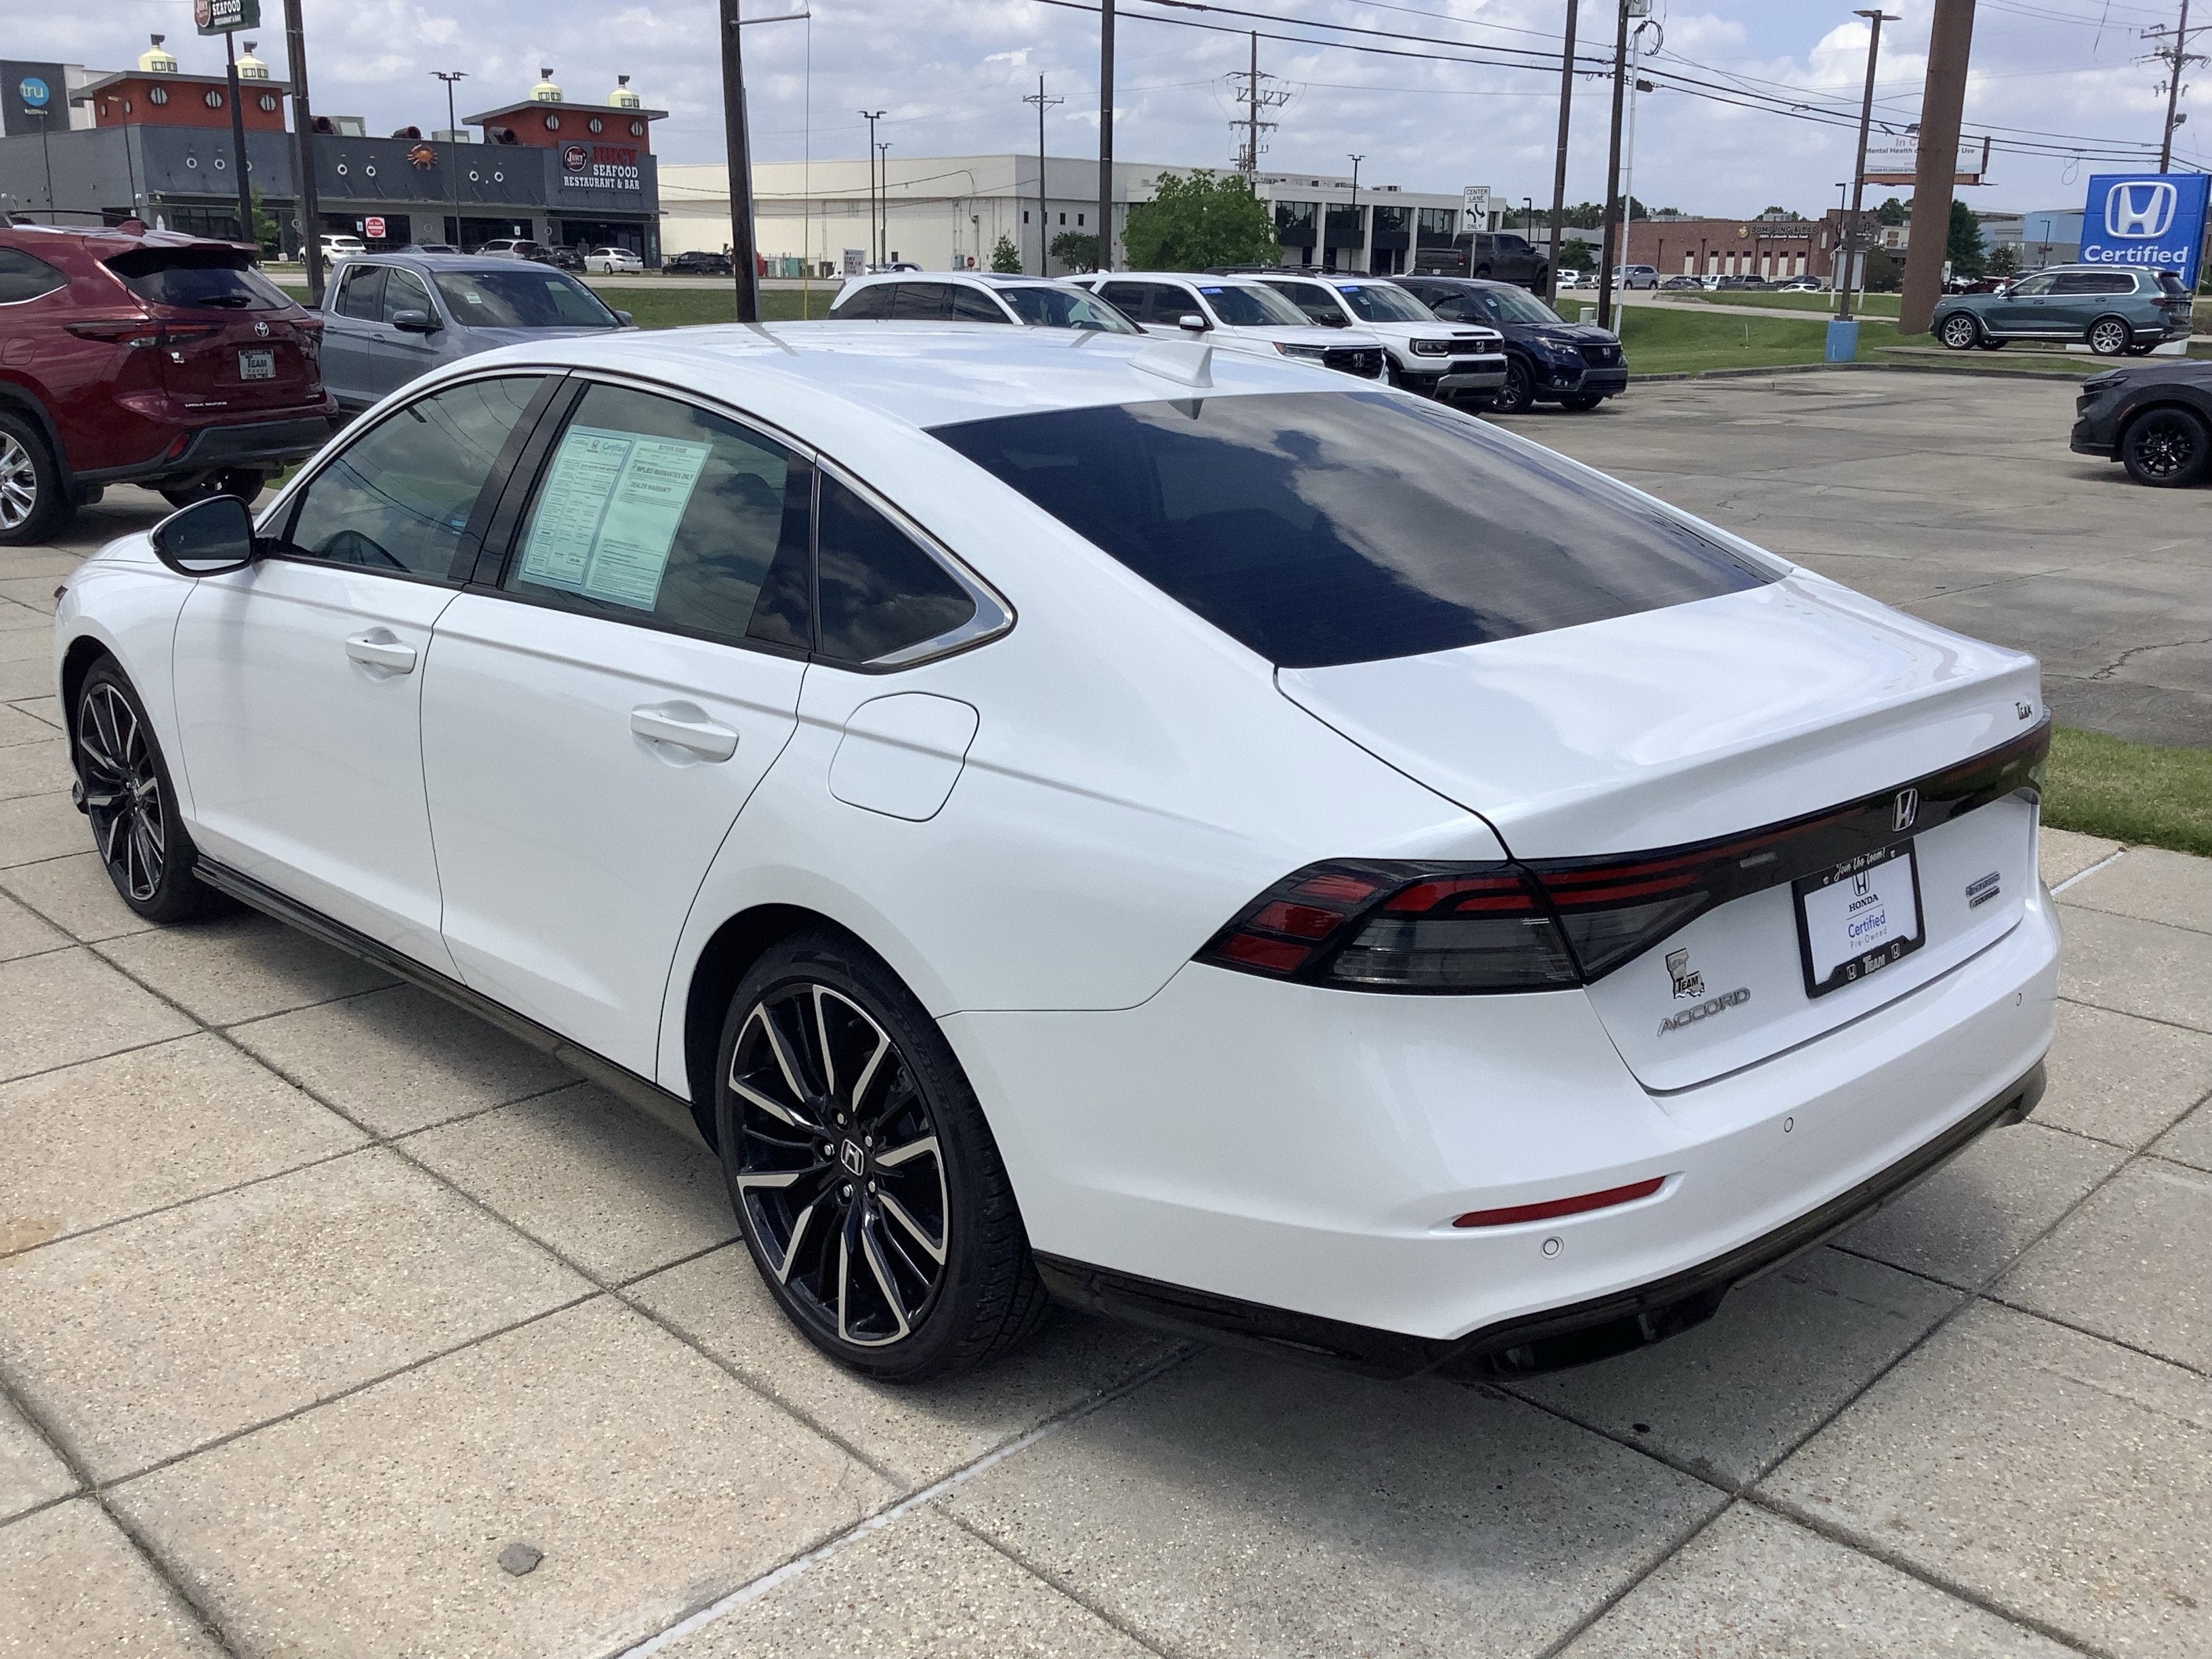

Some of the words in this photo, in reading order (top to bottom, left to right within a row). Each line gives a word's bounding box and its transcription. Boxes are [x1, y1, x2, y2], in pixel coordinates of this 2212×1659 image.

[212, 1, 241, 16] SEAFOOD
[20, 83, 44, 98] tru
[593, 164, 638, 178] SEAFOOD
[564, 176, 615, 188] RESTAURANT
[617, 178, 623, 189] &
[625, 180, 640, 190] BAR
[2084, 245, 2188, 263] Certified
[631, 481, 648, 489] DEALER
[647, 483, 672, 493] WARRANTY
[1834, 863, 1852, 882] Join
[1853, 856, 1866, 870] the
[1849, 894, 1879, 912] HONDA
[1848, 909, 1886, 938] Certified
[1863, 954, 1885, 974] TEAM
[1676, 975, 1699, 992] TEAM
[1657, 987, 1751, 1037] ACCORD
